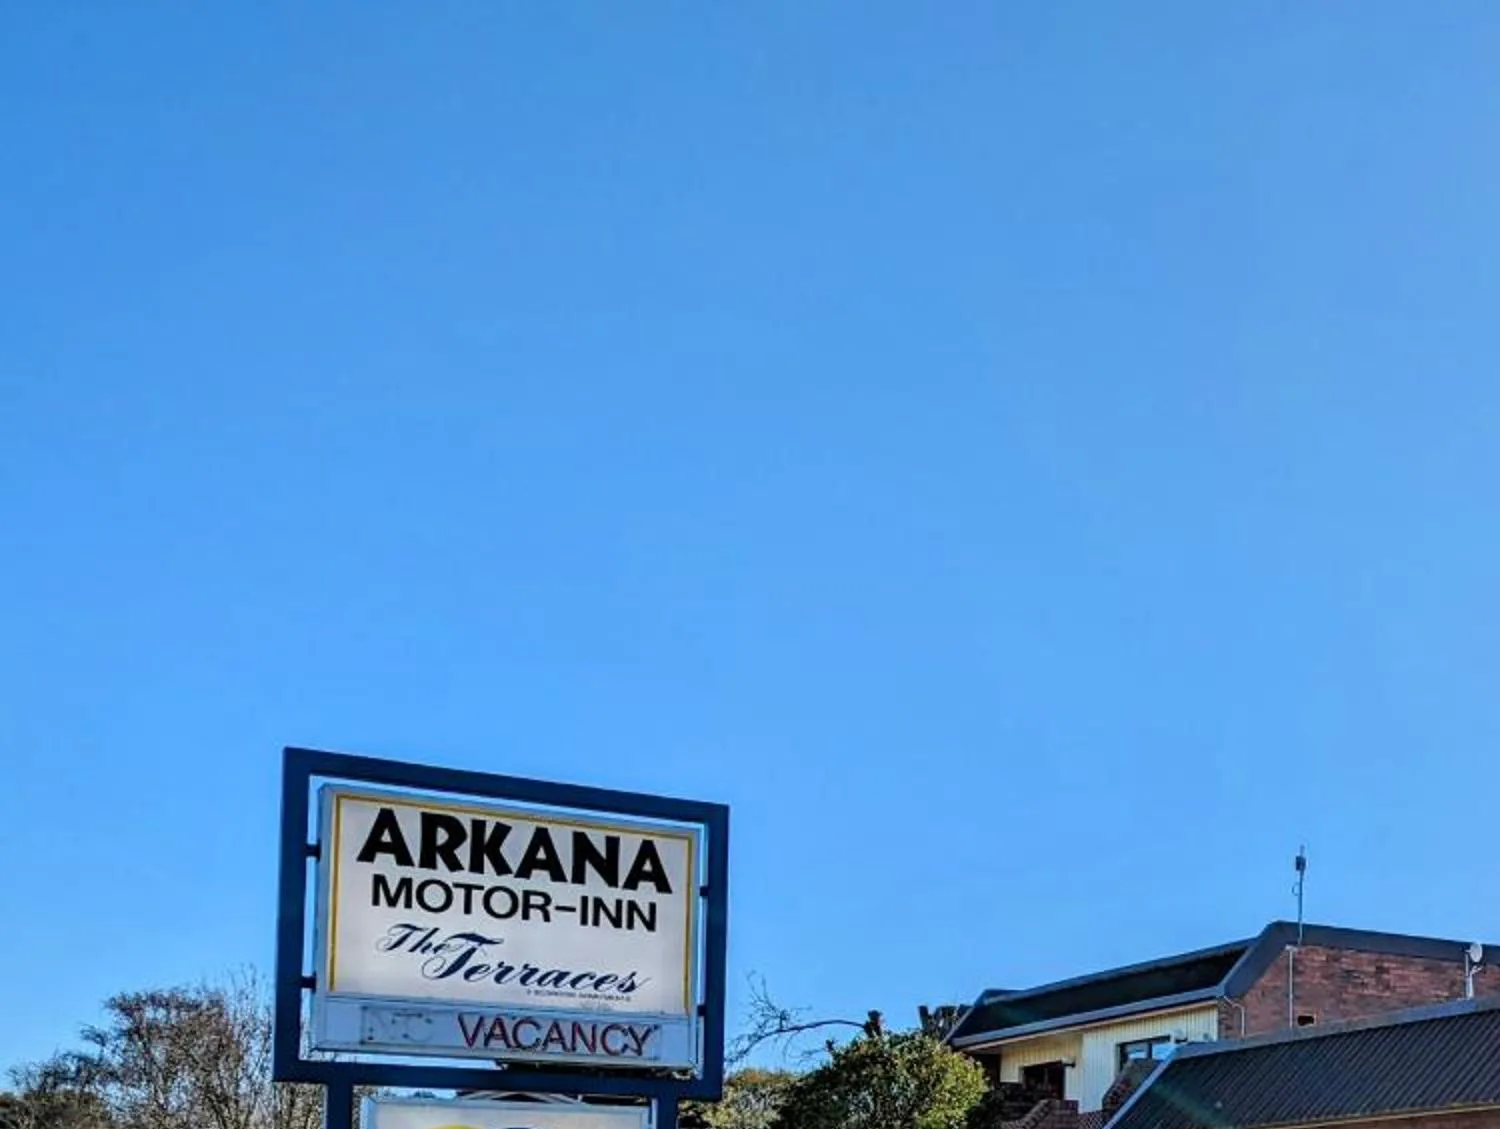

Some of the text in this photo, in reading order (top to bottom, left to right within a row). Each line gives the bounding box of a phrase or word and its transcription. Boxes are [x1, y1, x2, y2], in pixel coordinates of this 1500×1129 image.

[356, 808, 673, 894] ARKANA
[371, 874, 657, 932] MOTOR-INN
[376, 922, 650, 994] The Terraces
[458, 1012, 659, 1057] VACANCY
